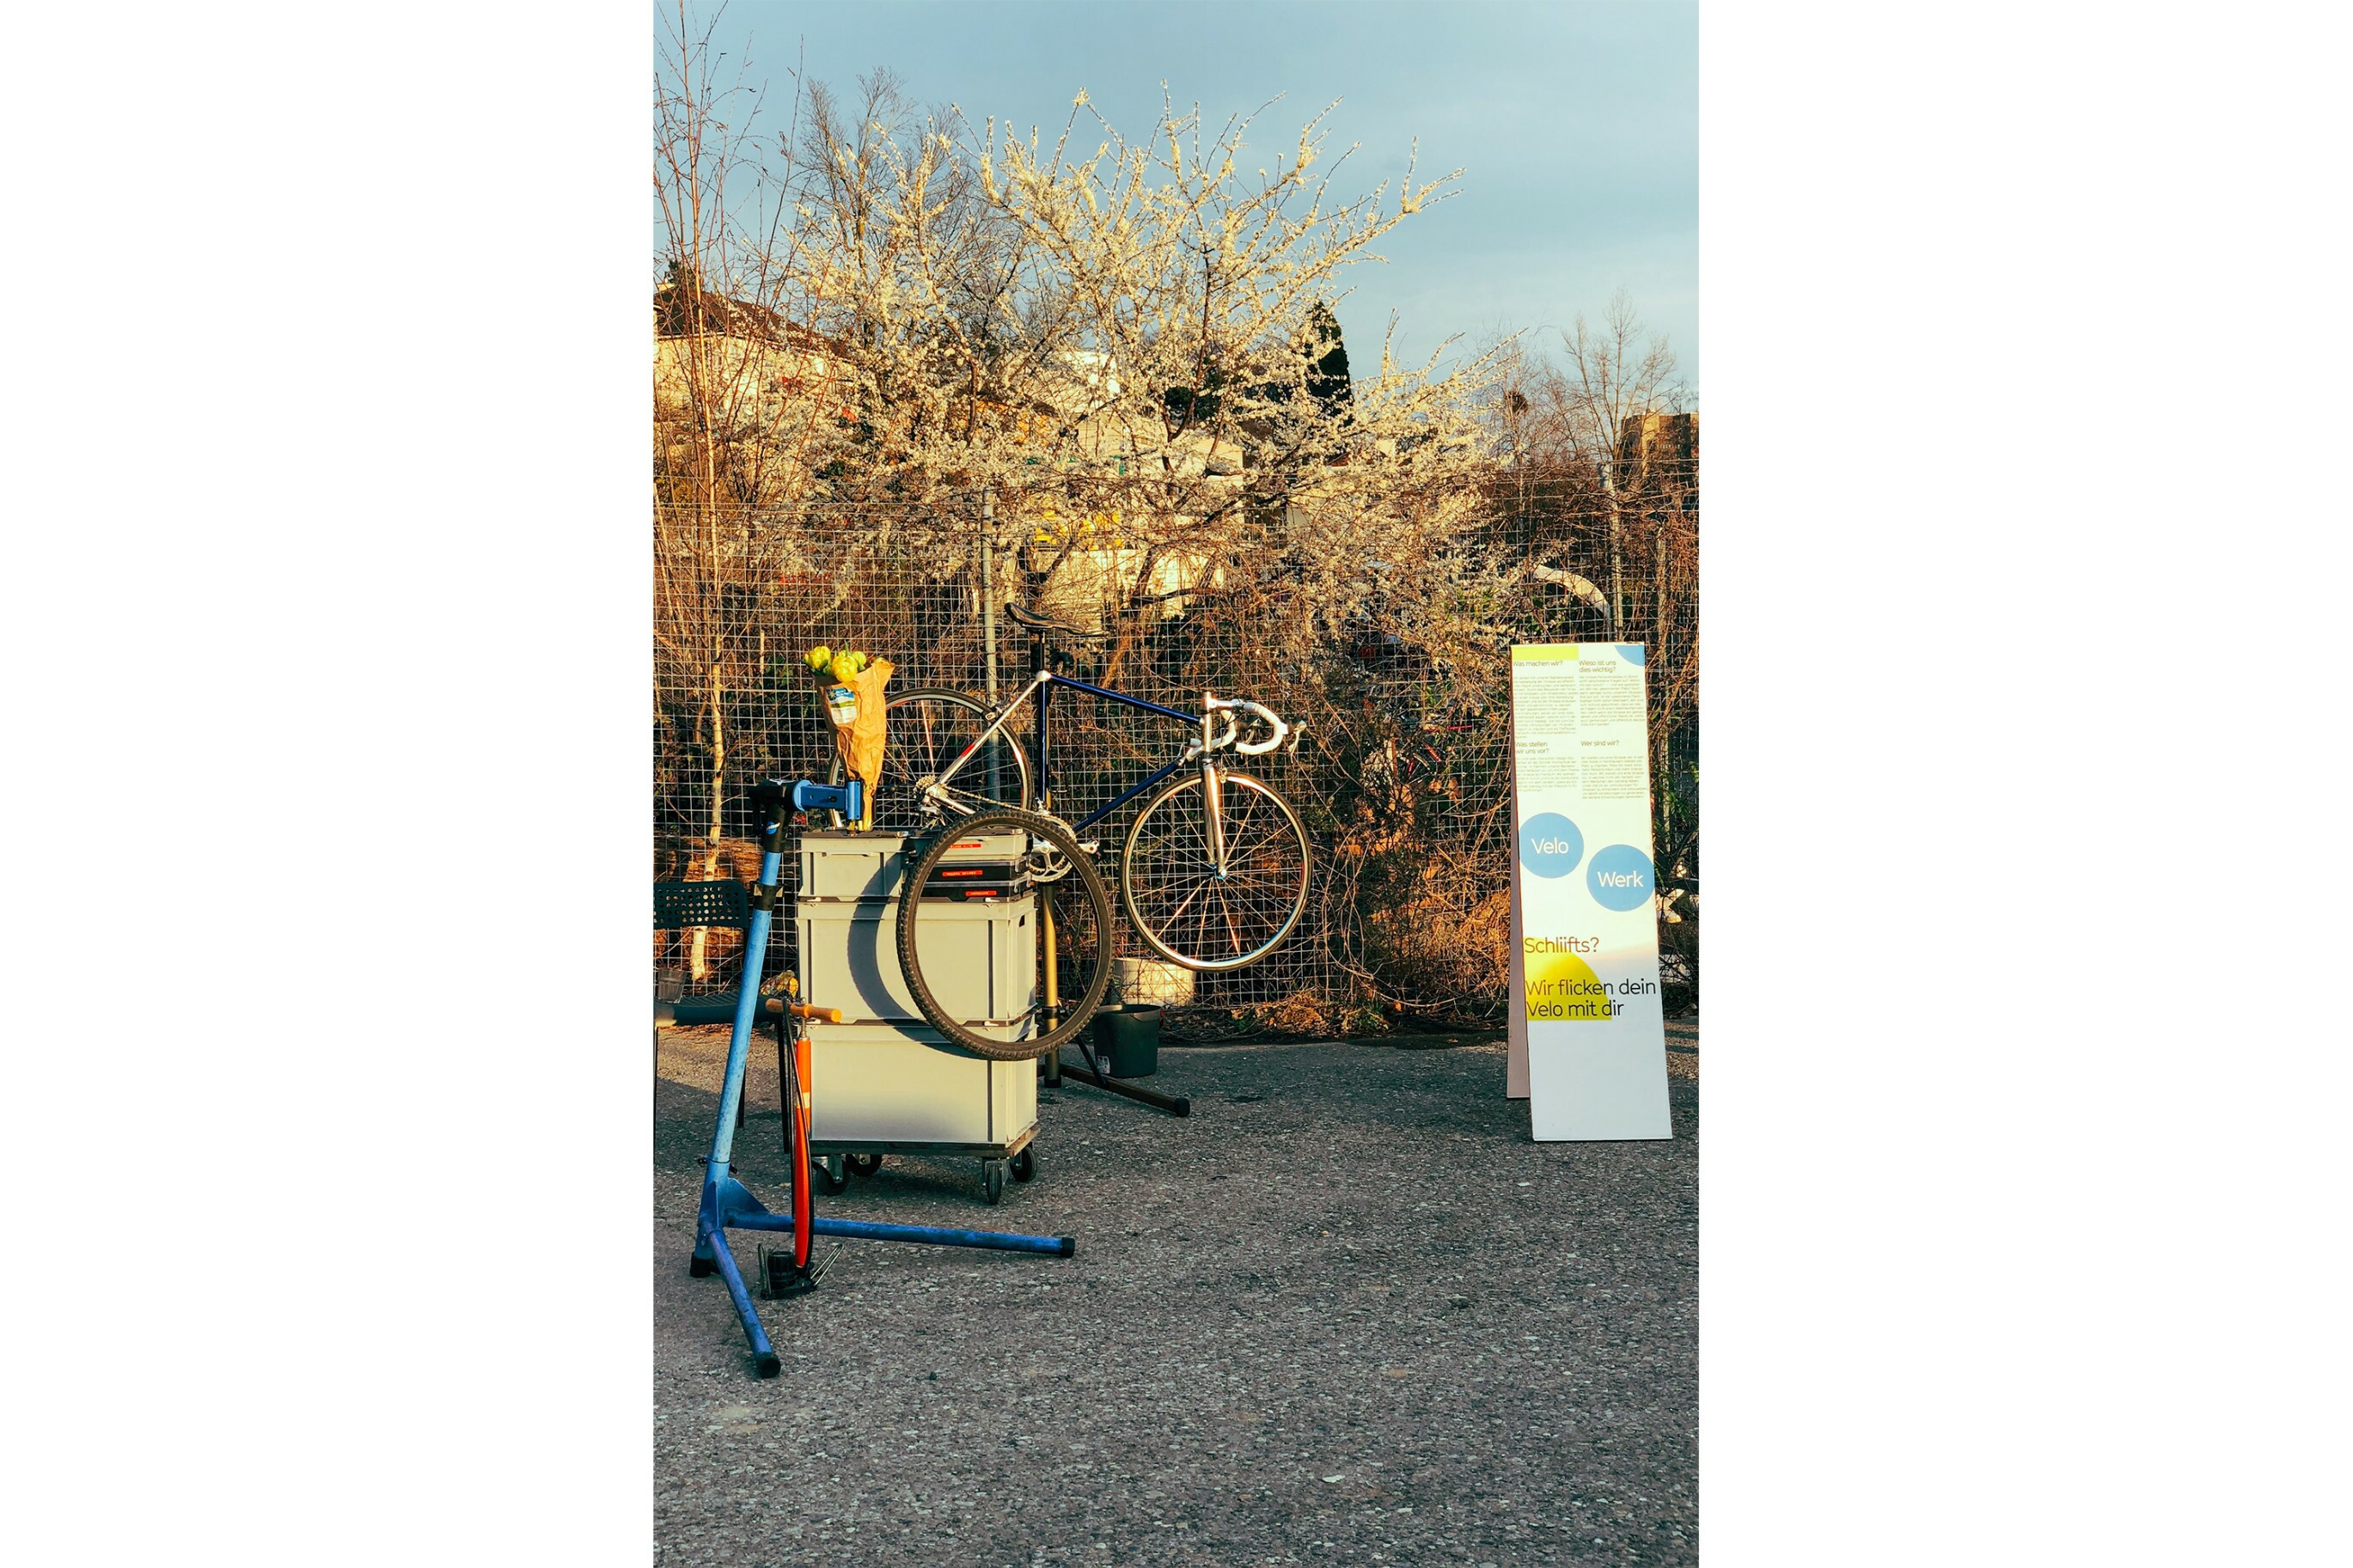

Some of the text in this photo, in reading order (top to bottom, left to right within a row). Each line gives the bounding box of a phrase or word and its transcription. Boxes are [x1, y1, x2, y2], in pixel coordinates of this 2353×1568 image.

[1531, 837, 1569, 854] Velo
[1597, 870, 1644, 888] Werk
[1525, 937, 1599, 954] Schliifts?
[1525, 978, 1656, 996] Wir flicken dein
[1526, 999, 1624, 1016] Velo mit dir
